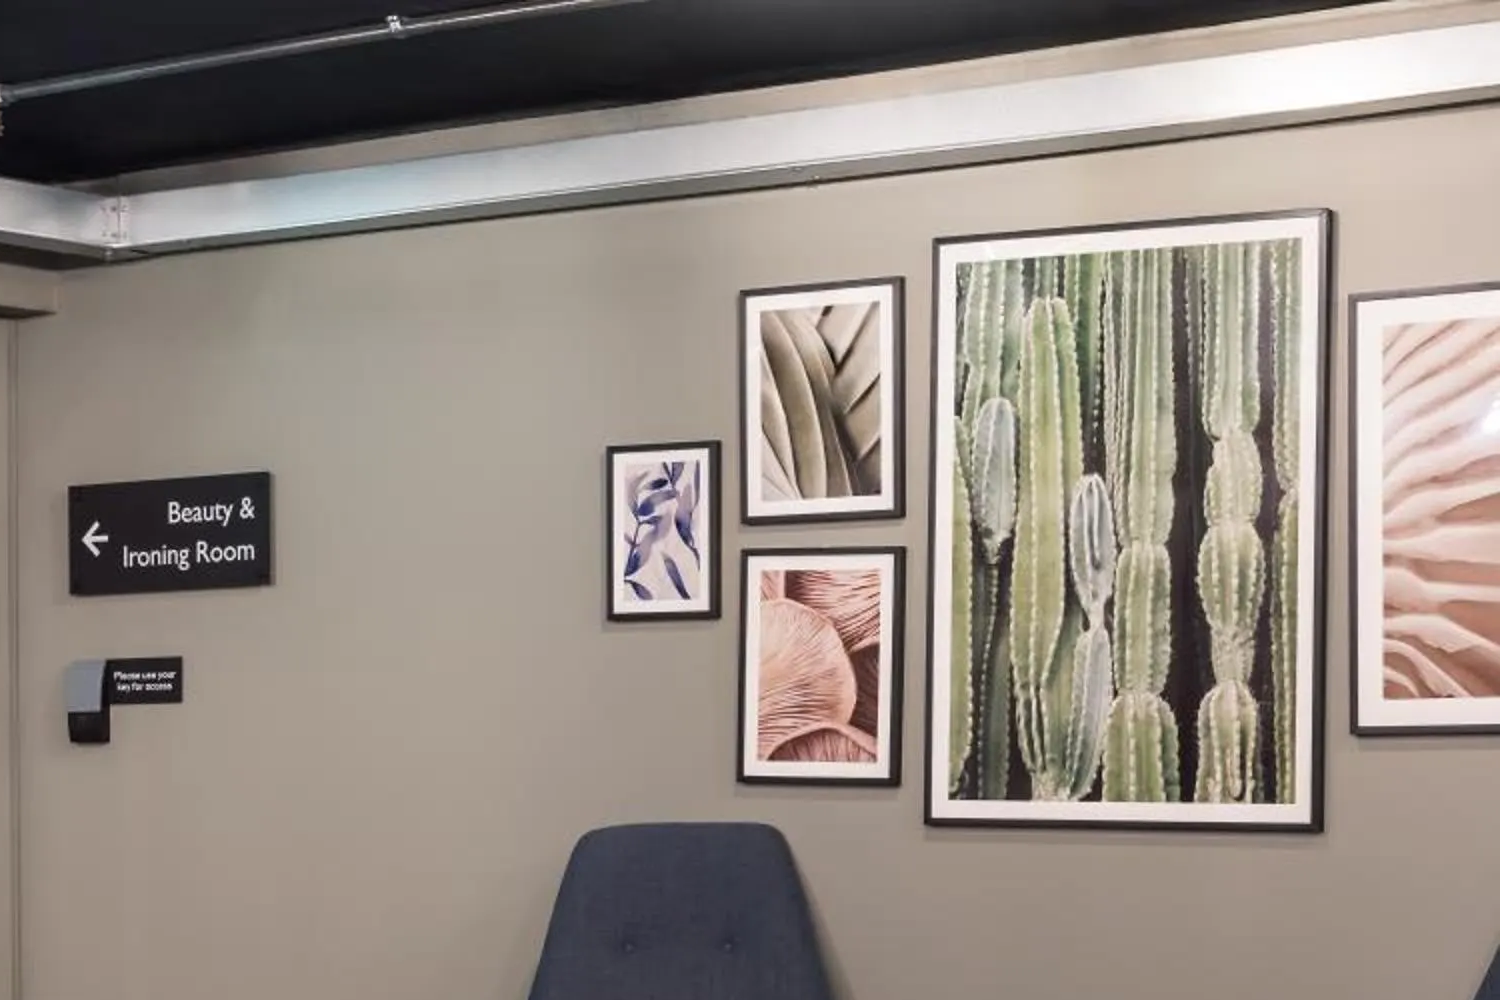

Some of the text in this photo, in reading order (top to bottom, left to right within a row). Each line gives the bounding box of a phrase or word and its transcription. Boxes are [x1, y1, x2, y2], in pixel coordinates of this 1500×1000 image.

[167, 496, 255, 527] Beauty &
[123, 540, 255, 571] Ironing Room
